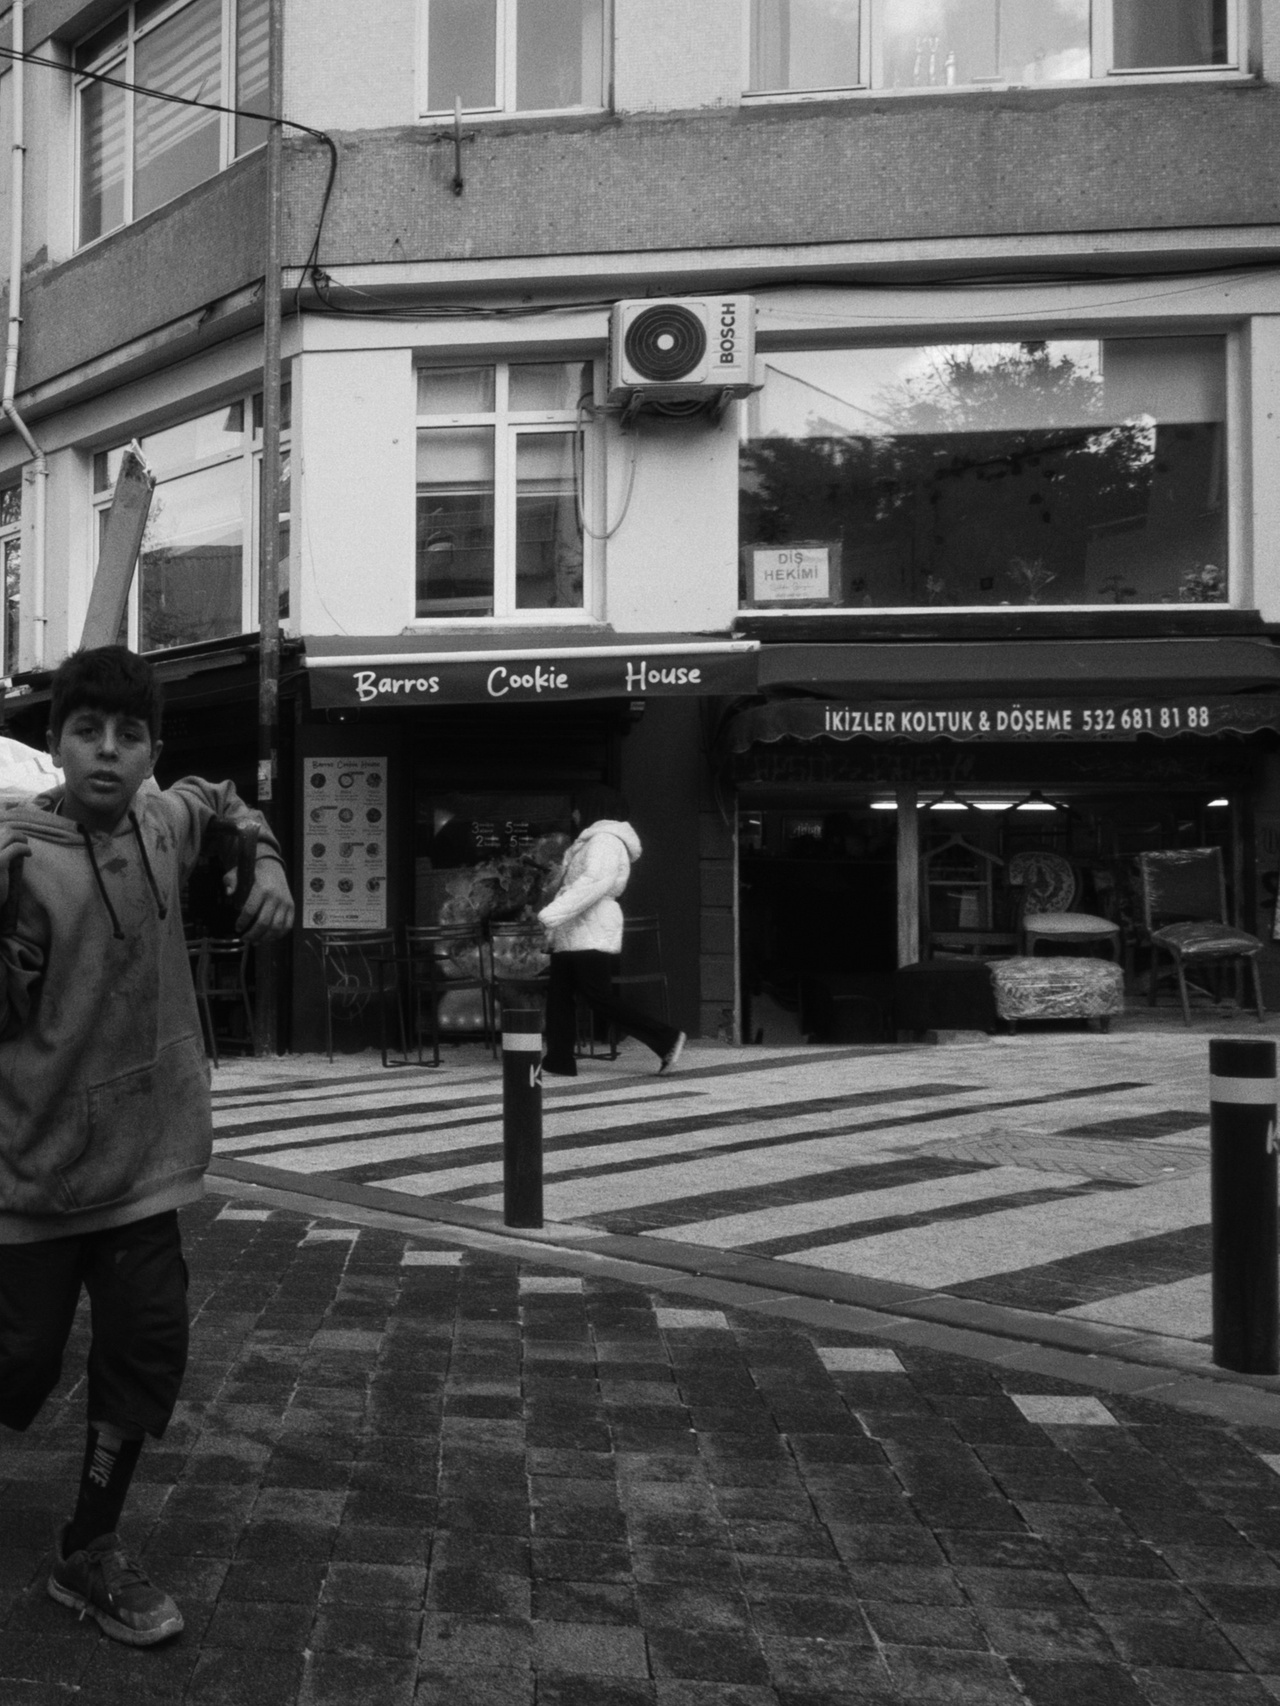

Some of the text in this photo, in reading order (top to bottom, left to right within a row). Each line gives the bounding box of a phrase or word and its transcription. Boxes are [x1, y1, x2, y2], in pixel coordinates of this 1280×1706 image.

[720, 303, 736, 364] BOSCH
[778, 549, 804, 565] DİŞ
[764, 564, 818, 581] HEKİMİ
[352, 661, 702, 702] Barros Cookie House
[825, 703, 1209, 732] İKİZLER KOLTUK & DÖŞEME 532 681 81 88
